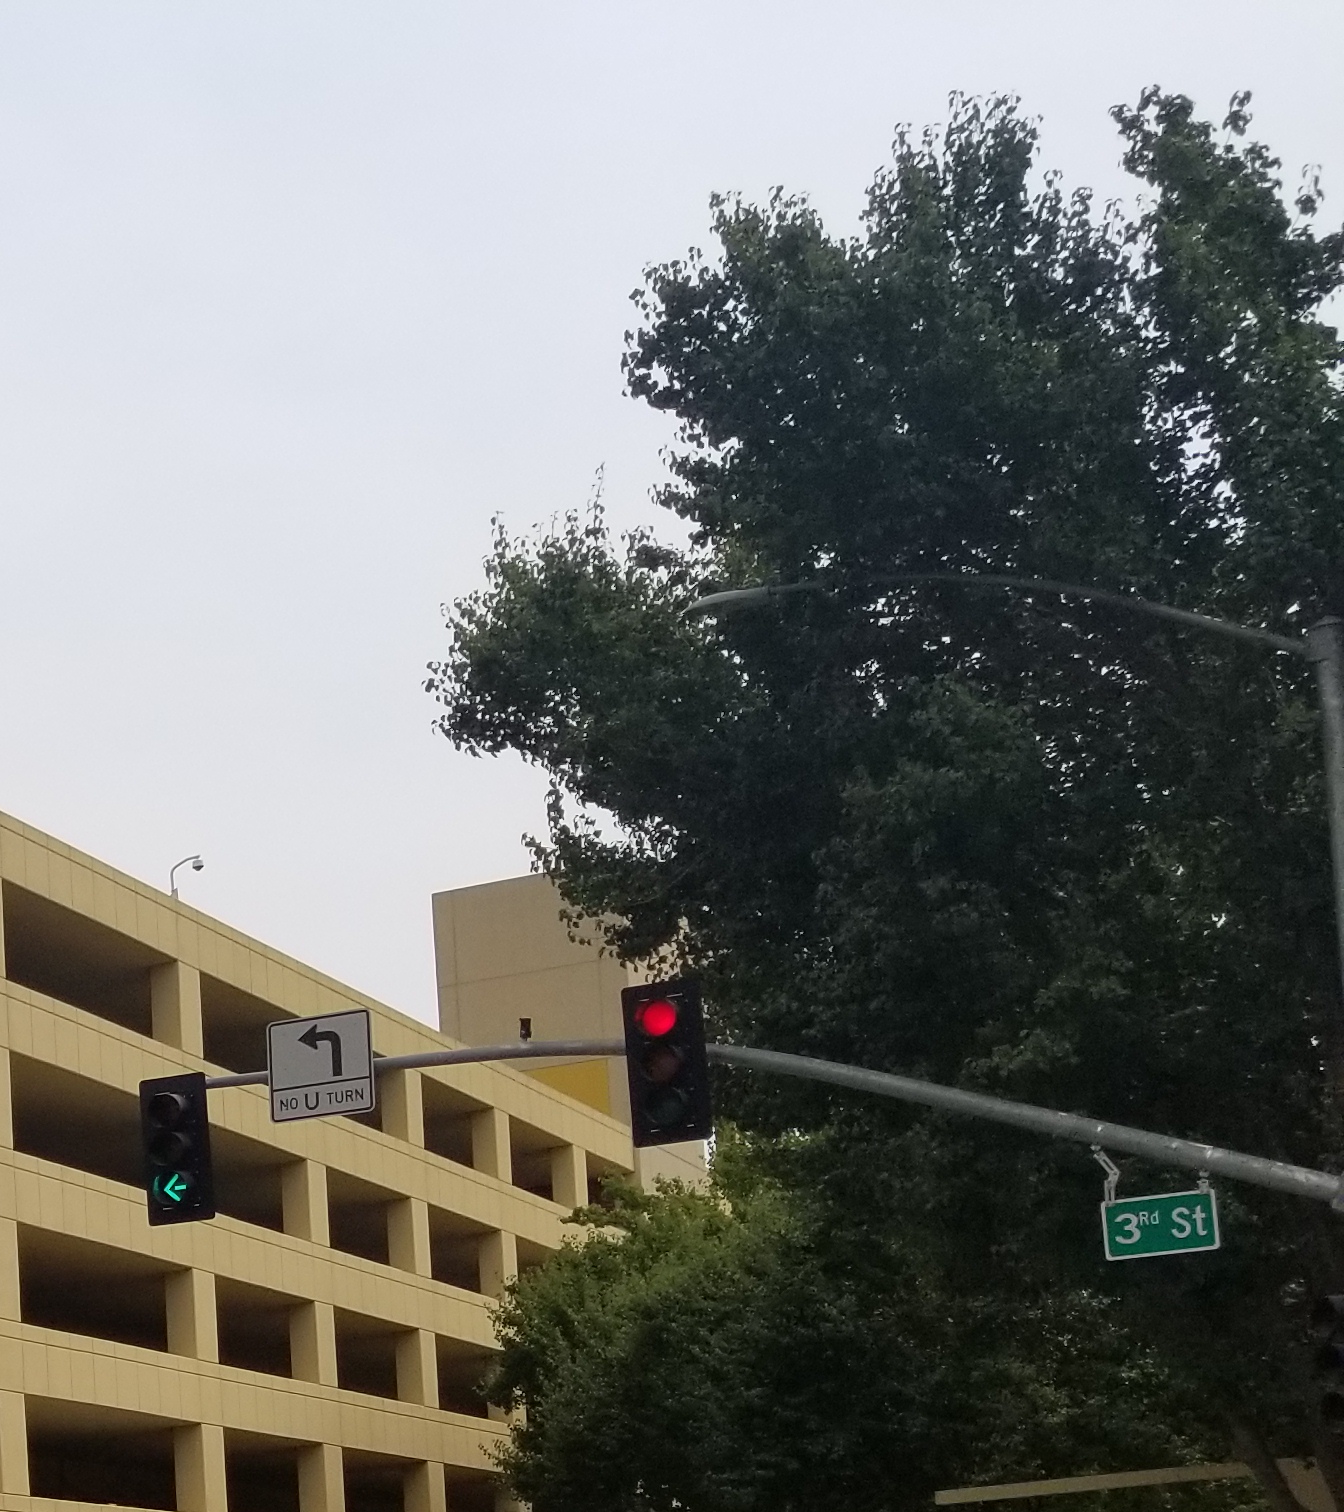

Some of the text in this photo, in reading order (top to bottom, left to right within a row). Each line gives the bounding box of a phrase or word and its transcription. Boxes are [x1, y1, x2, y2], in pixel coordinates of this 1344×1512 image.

[279, 1088, 364, 1111] NO U TURN
[1171, 1204, 1208, 1239] St
